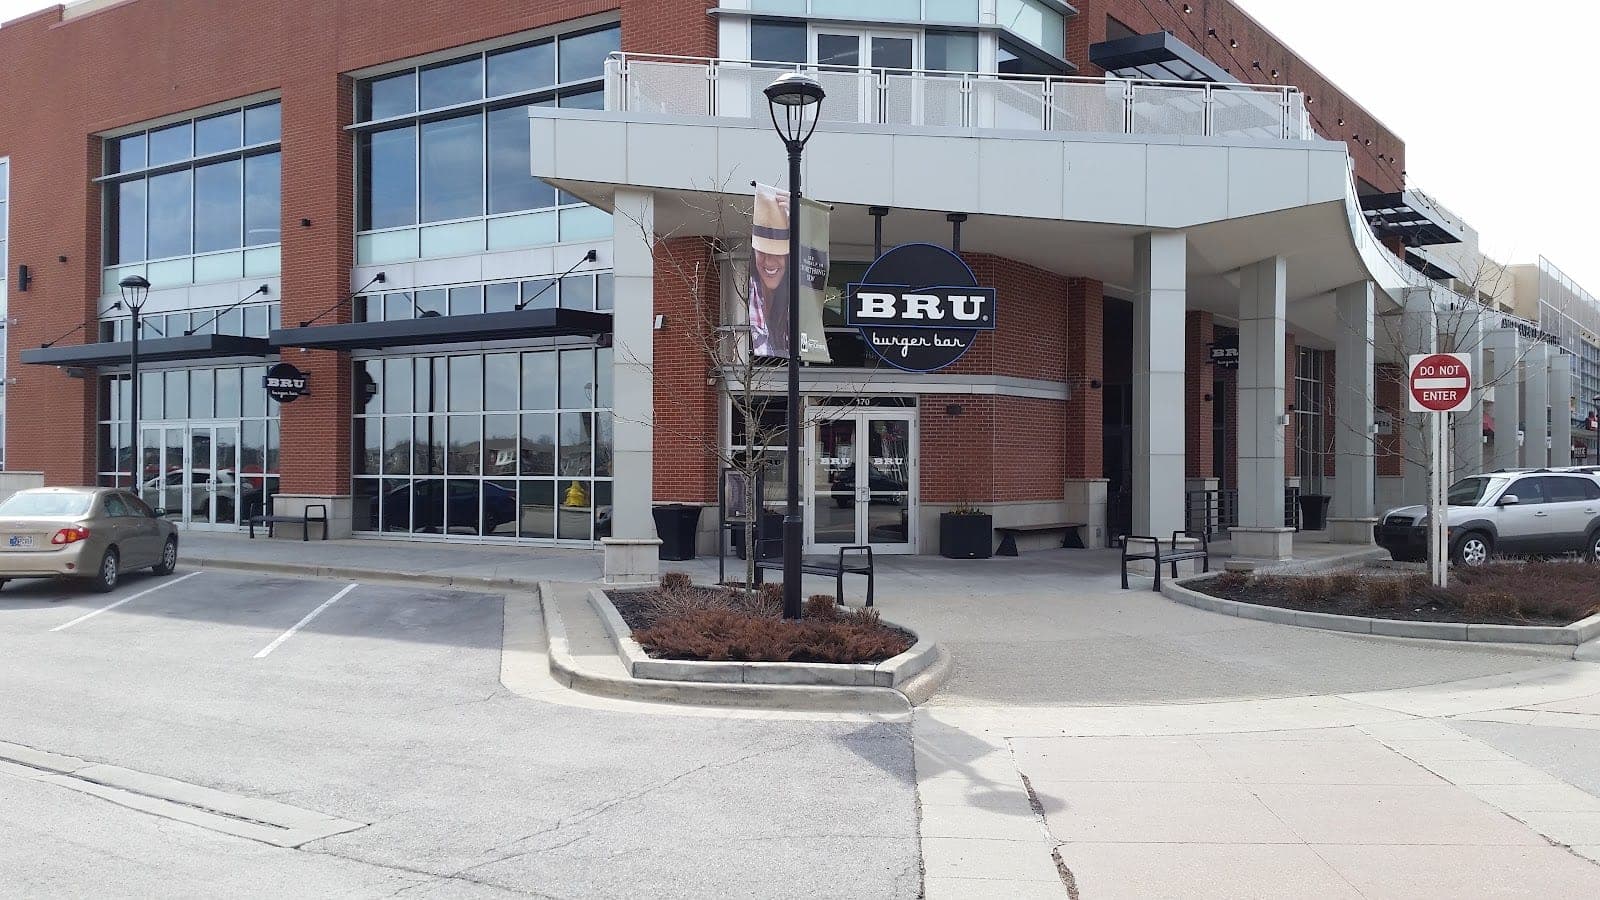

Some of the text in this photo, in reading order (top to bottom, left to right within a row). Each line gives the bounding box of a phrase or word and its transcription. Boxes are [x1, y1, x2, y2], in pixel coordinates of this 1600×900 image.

[872, 331, 966, 358] burger bar
[1211, 347, 1239, 357] BR
[1419, 365, 1460, 376] DO NOT
[267, 378, 304, 388] BRU
[1423, 391, 1457, 401] ENTER
[855, 397, 870, 406] 170
[820, 457, 851, 465] BRU
[873, 457, 904, 465] BRU
